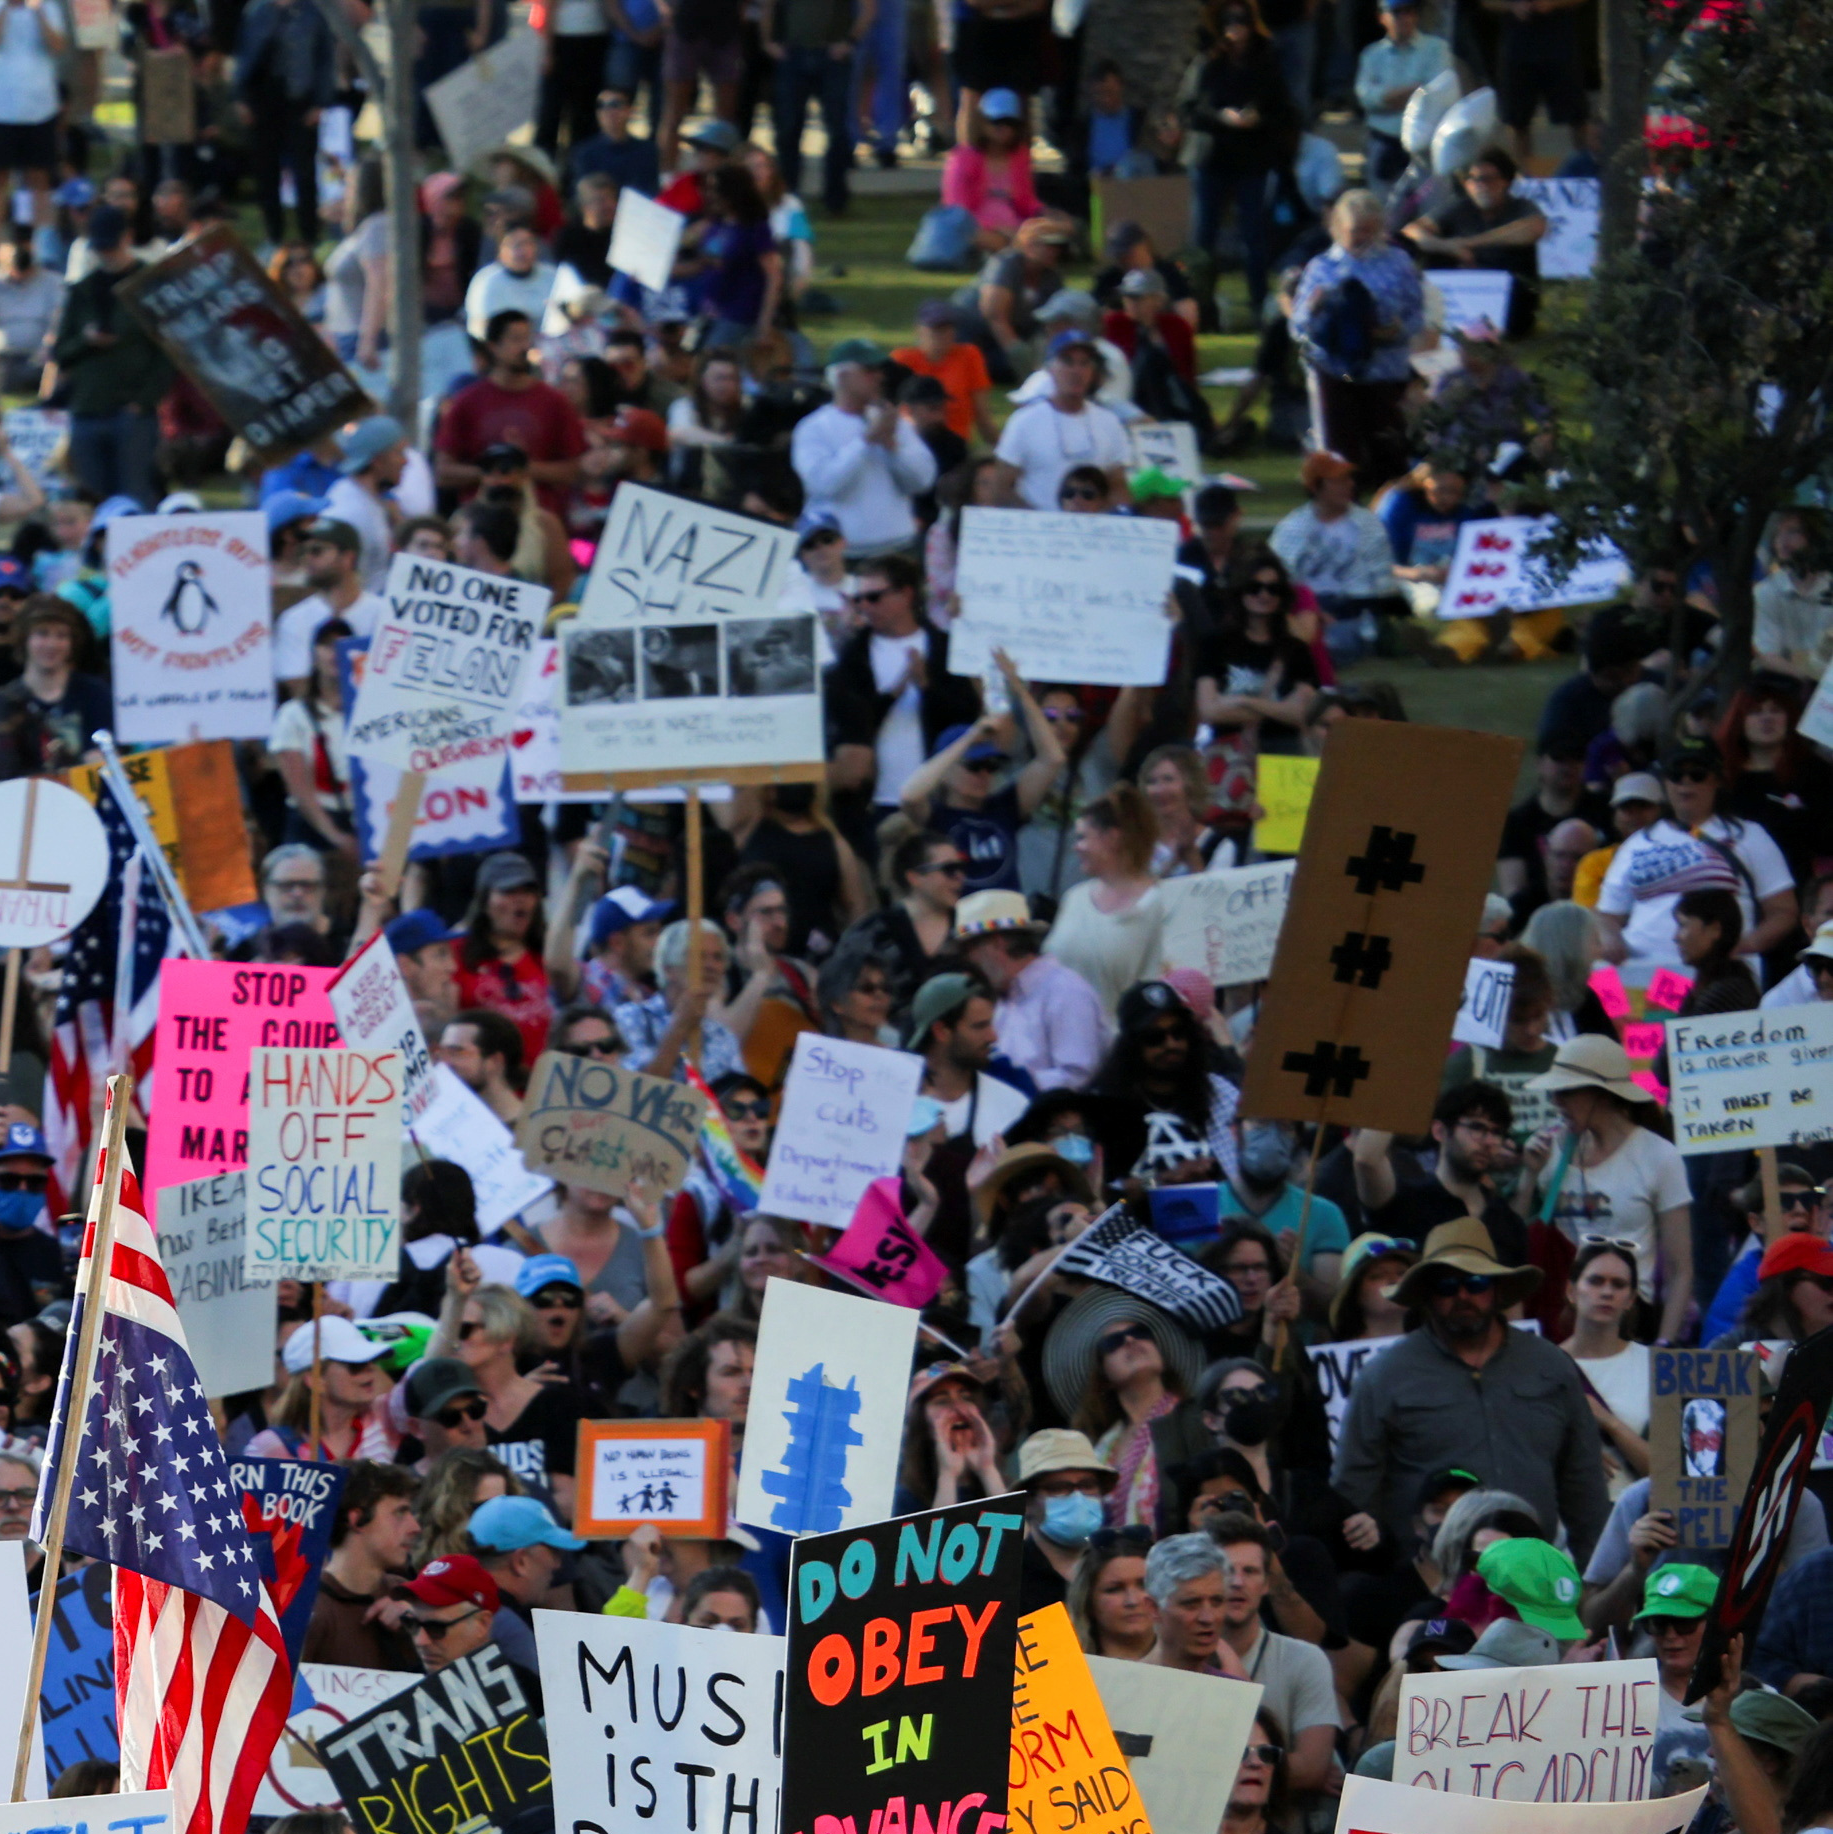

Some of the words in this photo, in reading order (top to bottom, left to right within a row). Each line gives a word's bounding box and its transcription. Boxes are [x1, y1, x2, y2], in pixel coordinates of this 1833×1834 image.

[617, 499, 780, 596] NAZI
[407, 563, 453, 596] NO
[462, 577, 520, 612] ONE
[390, 595, 480, 637] VOTED
[485, 612, 533, 651] FOR
[372, 626, 520, 698] FELON
[232, 971, 306, 1007] STOP
[174, 1015, 228, 1051] THE
[263, 1052, 397, 1107] HANDS
[280, 1111, 375, 1162] OFF
[258, 1162, 390, 1215] SOCIAL
[255, 1218, 397, 1264] SECURITY
[1128, 1232, 1218, 1288] FUCK
[1095, 1261, 1179, 1305] TRUMP
[1109, 1247, 1195, 1296] DONALD
[1654, 1352, 1753, 1397] BREAK
[1677, 1478, 1729, 1502] THE
[799, 1538, 877, 1626] DO
[894, 1510, 1024, 1589] NOT
[806, 1600, 1002, 1708] OBEY
[327, 1643, 529, 1789] TRANS
[1407, 1689, 1550, 1758] BREAK
[1575, 1680, 1656, 1741] THE
[862, 1713, 934, 1776] IN
